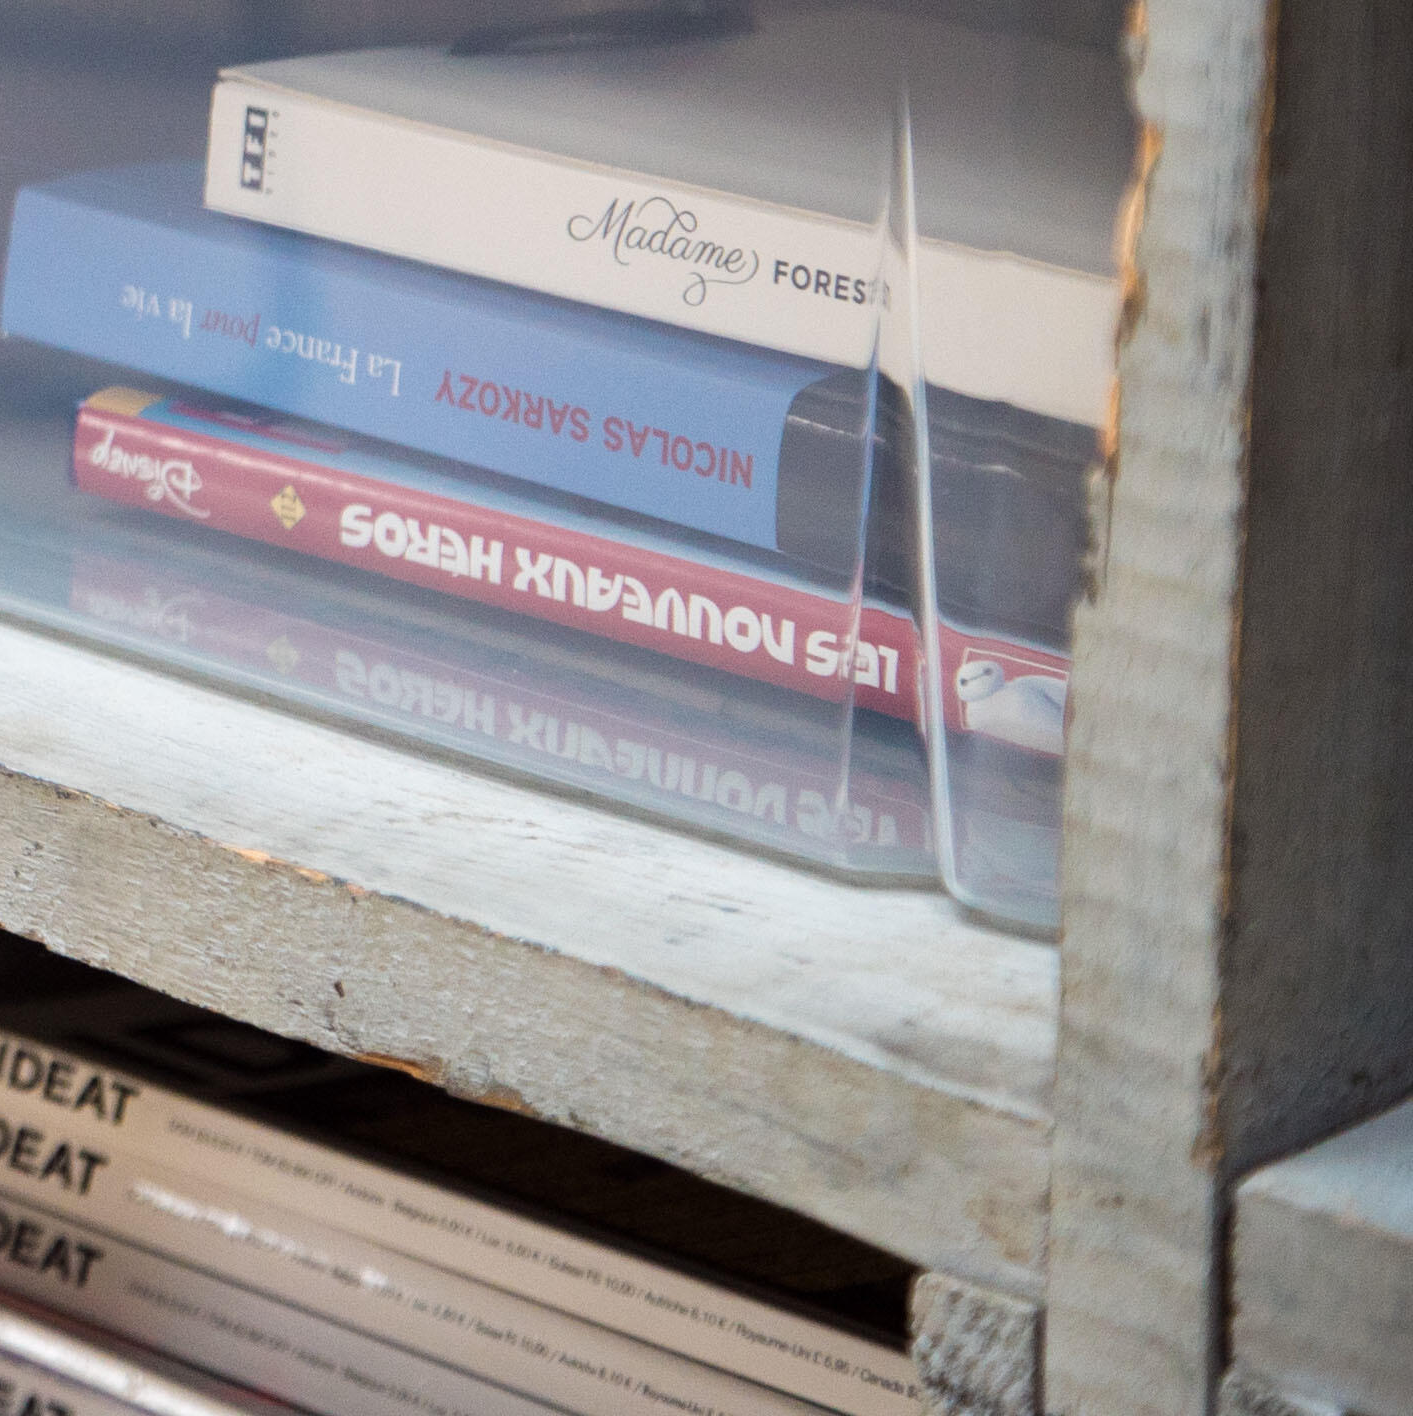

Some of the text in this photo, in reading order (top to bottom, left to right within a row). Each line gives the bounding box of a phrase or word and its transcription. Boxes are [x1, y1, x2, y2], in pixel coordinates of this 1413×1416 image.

[567, 197, 892, 311] Madame FORES
[122, 285, 755, 489] NICOLAS SARKOZY La France pour la vie
[513, 547, 796, 666] NOUVEAUX
